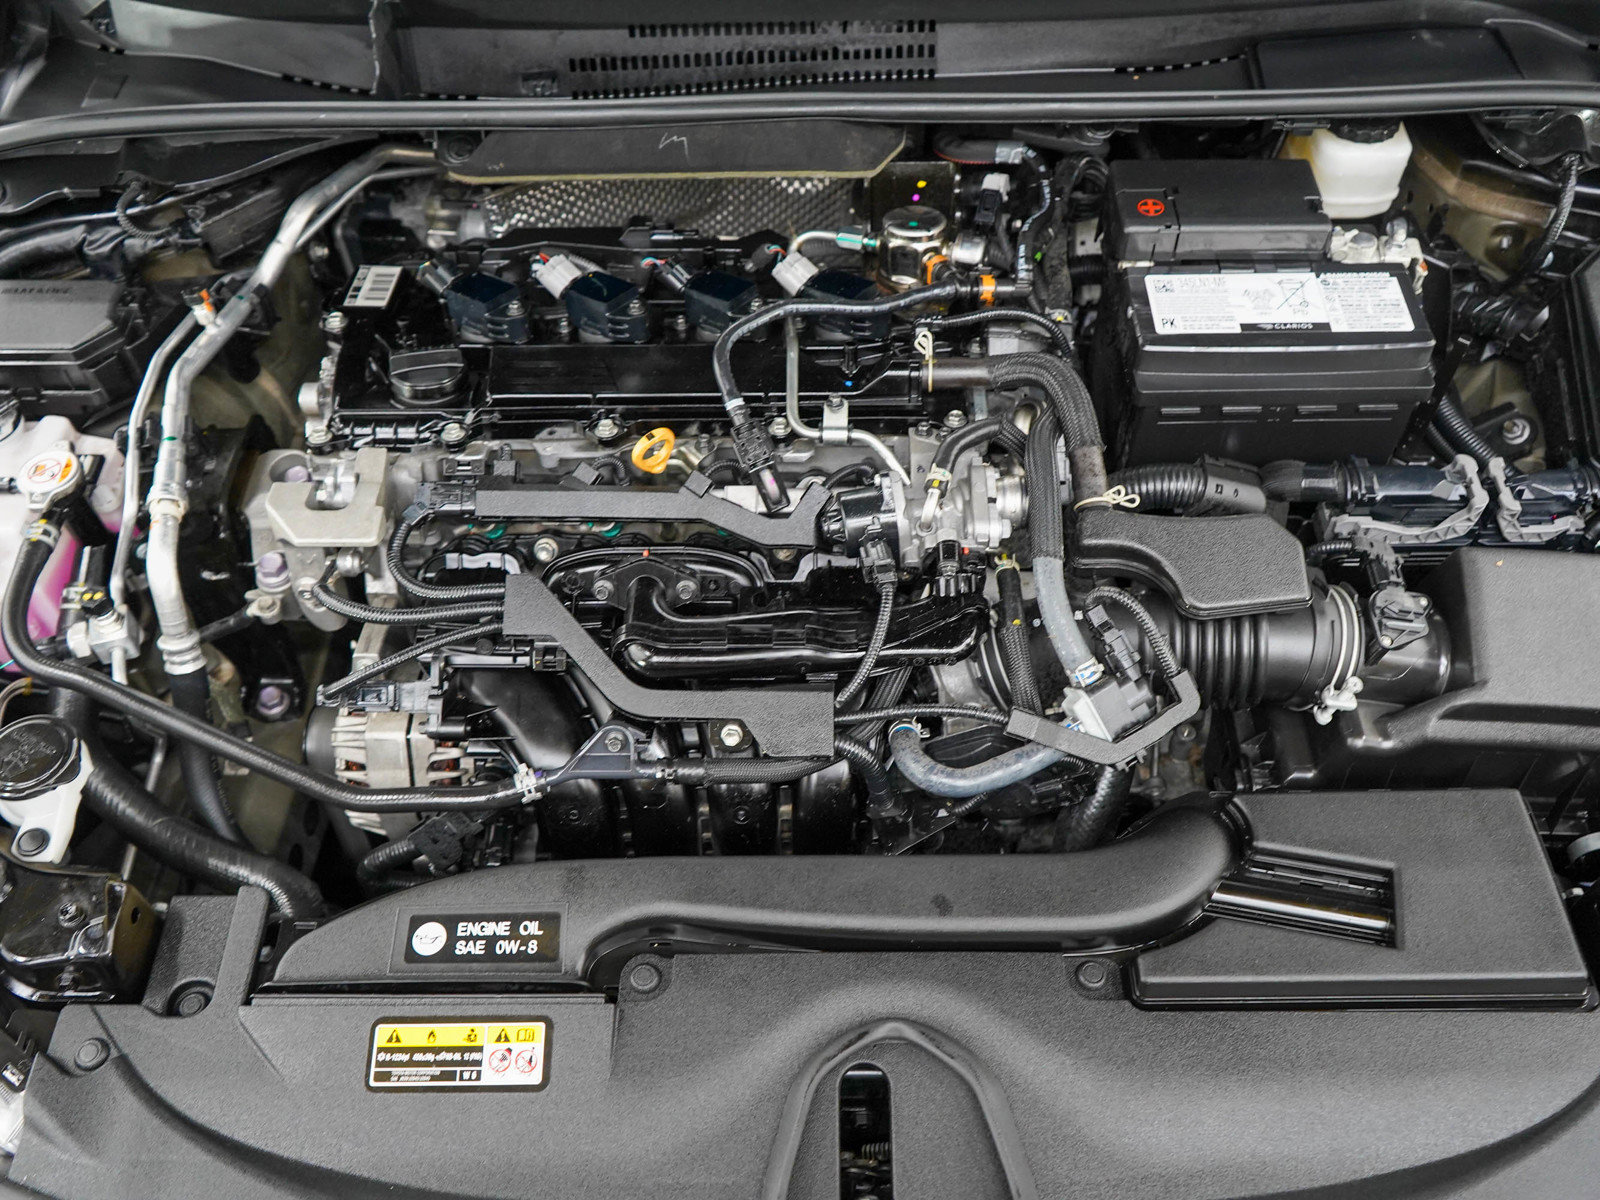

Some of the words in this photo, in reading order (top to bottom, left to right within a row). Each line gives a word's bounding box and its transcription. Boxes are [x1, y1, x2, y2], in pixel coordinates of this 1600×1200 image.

[1161, 317, 1177, 328] PK
[456, 921, 512, 937] ENGINE
[518, 920, 544, 936] OIL
[454, 939, 487, 955] SAE
[495, 939, 538, 955] 0W-8
